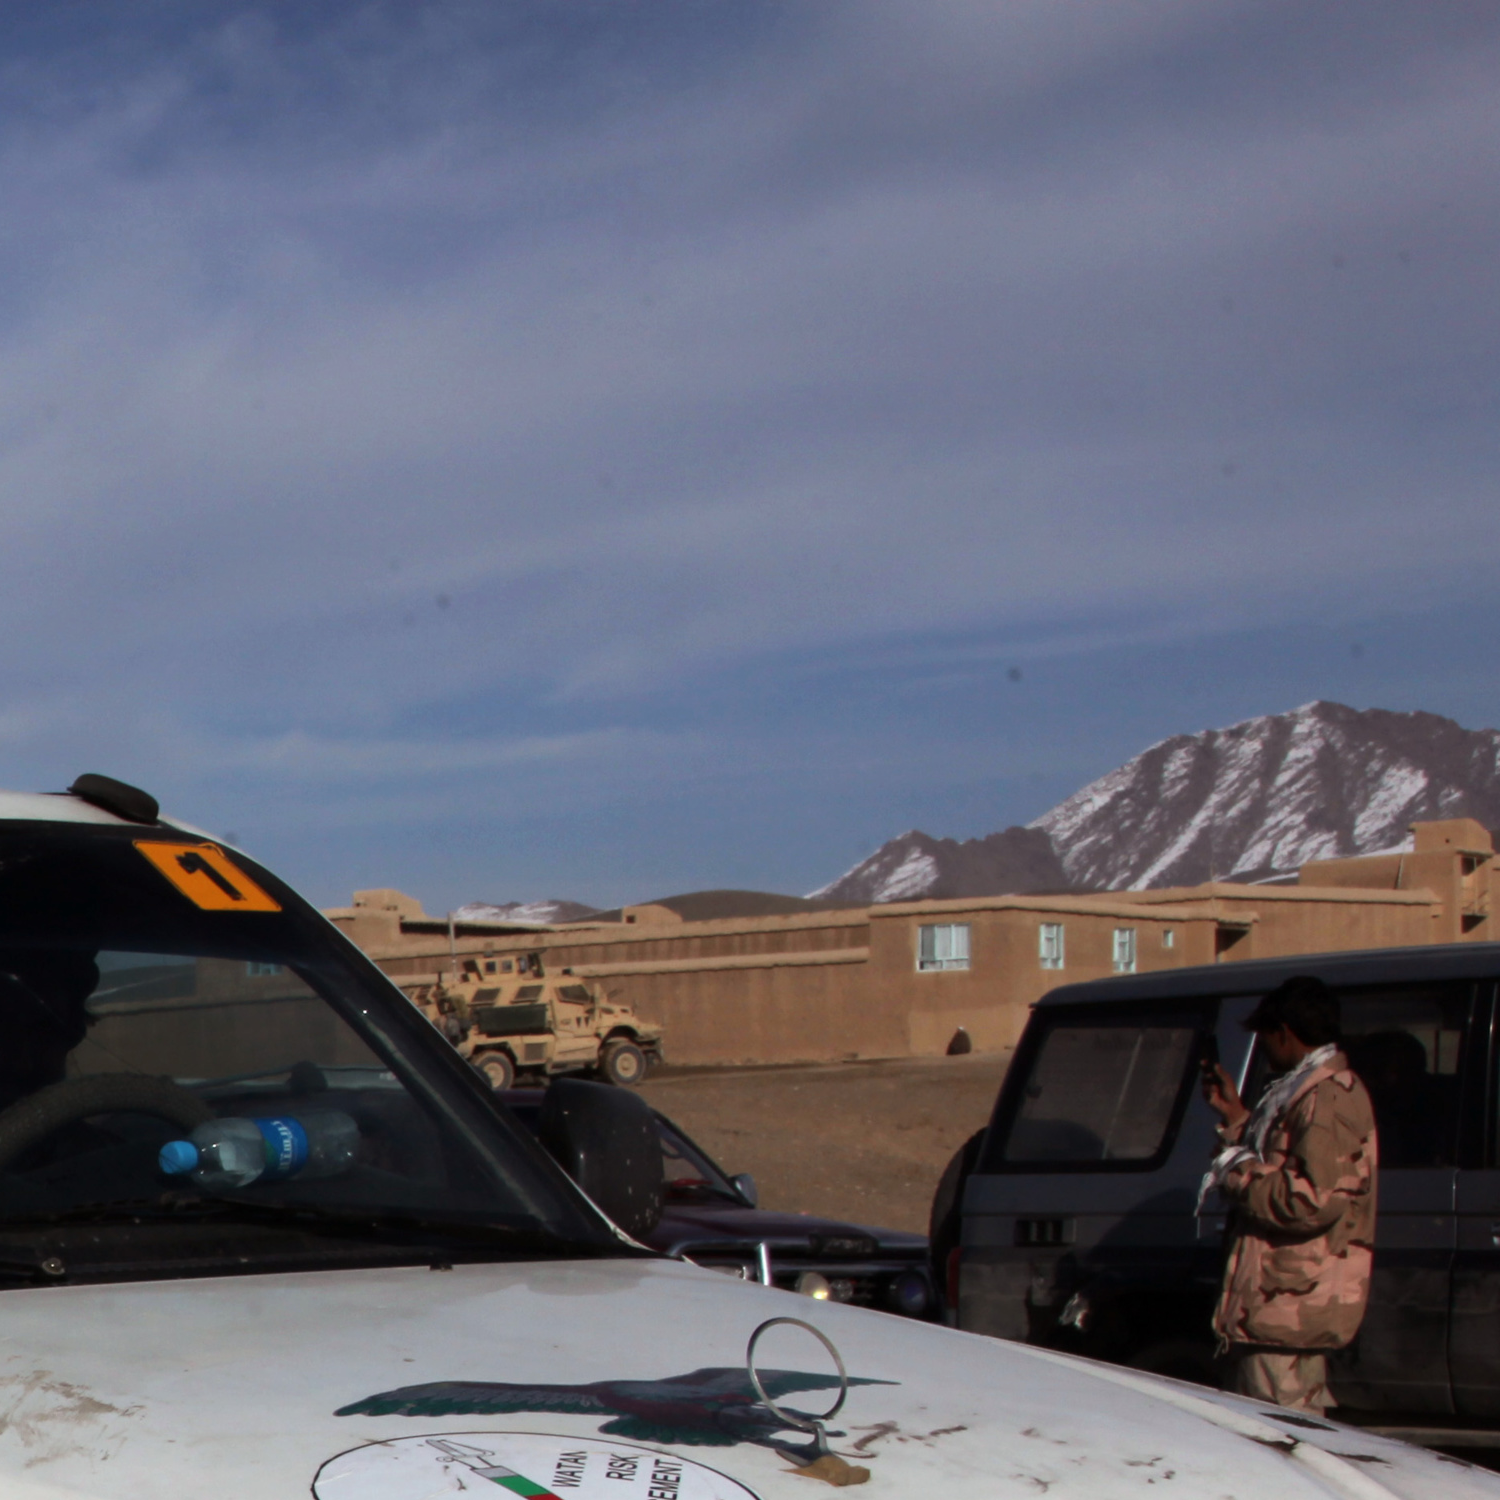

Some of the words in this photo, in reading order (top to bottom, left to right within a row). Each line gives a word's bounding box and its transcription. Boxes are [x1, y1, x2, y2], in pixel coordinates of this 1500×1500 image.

[175, 852, 248, 901] 1
[551, 1450, 588, 1488] WATAN
[605, 1453, 639, 1482] RISK
